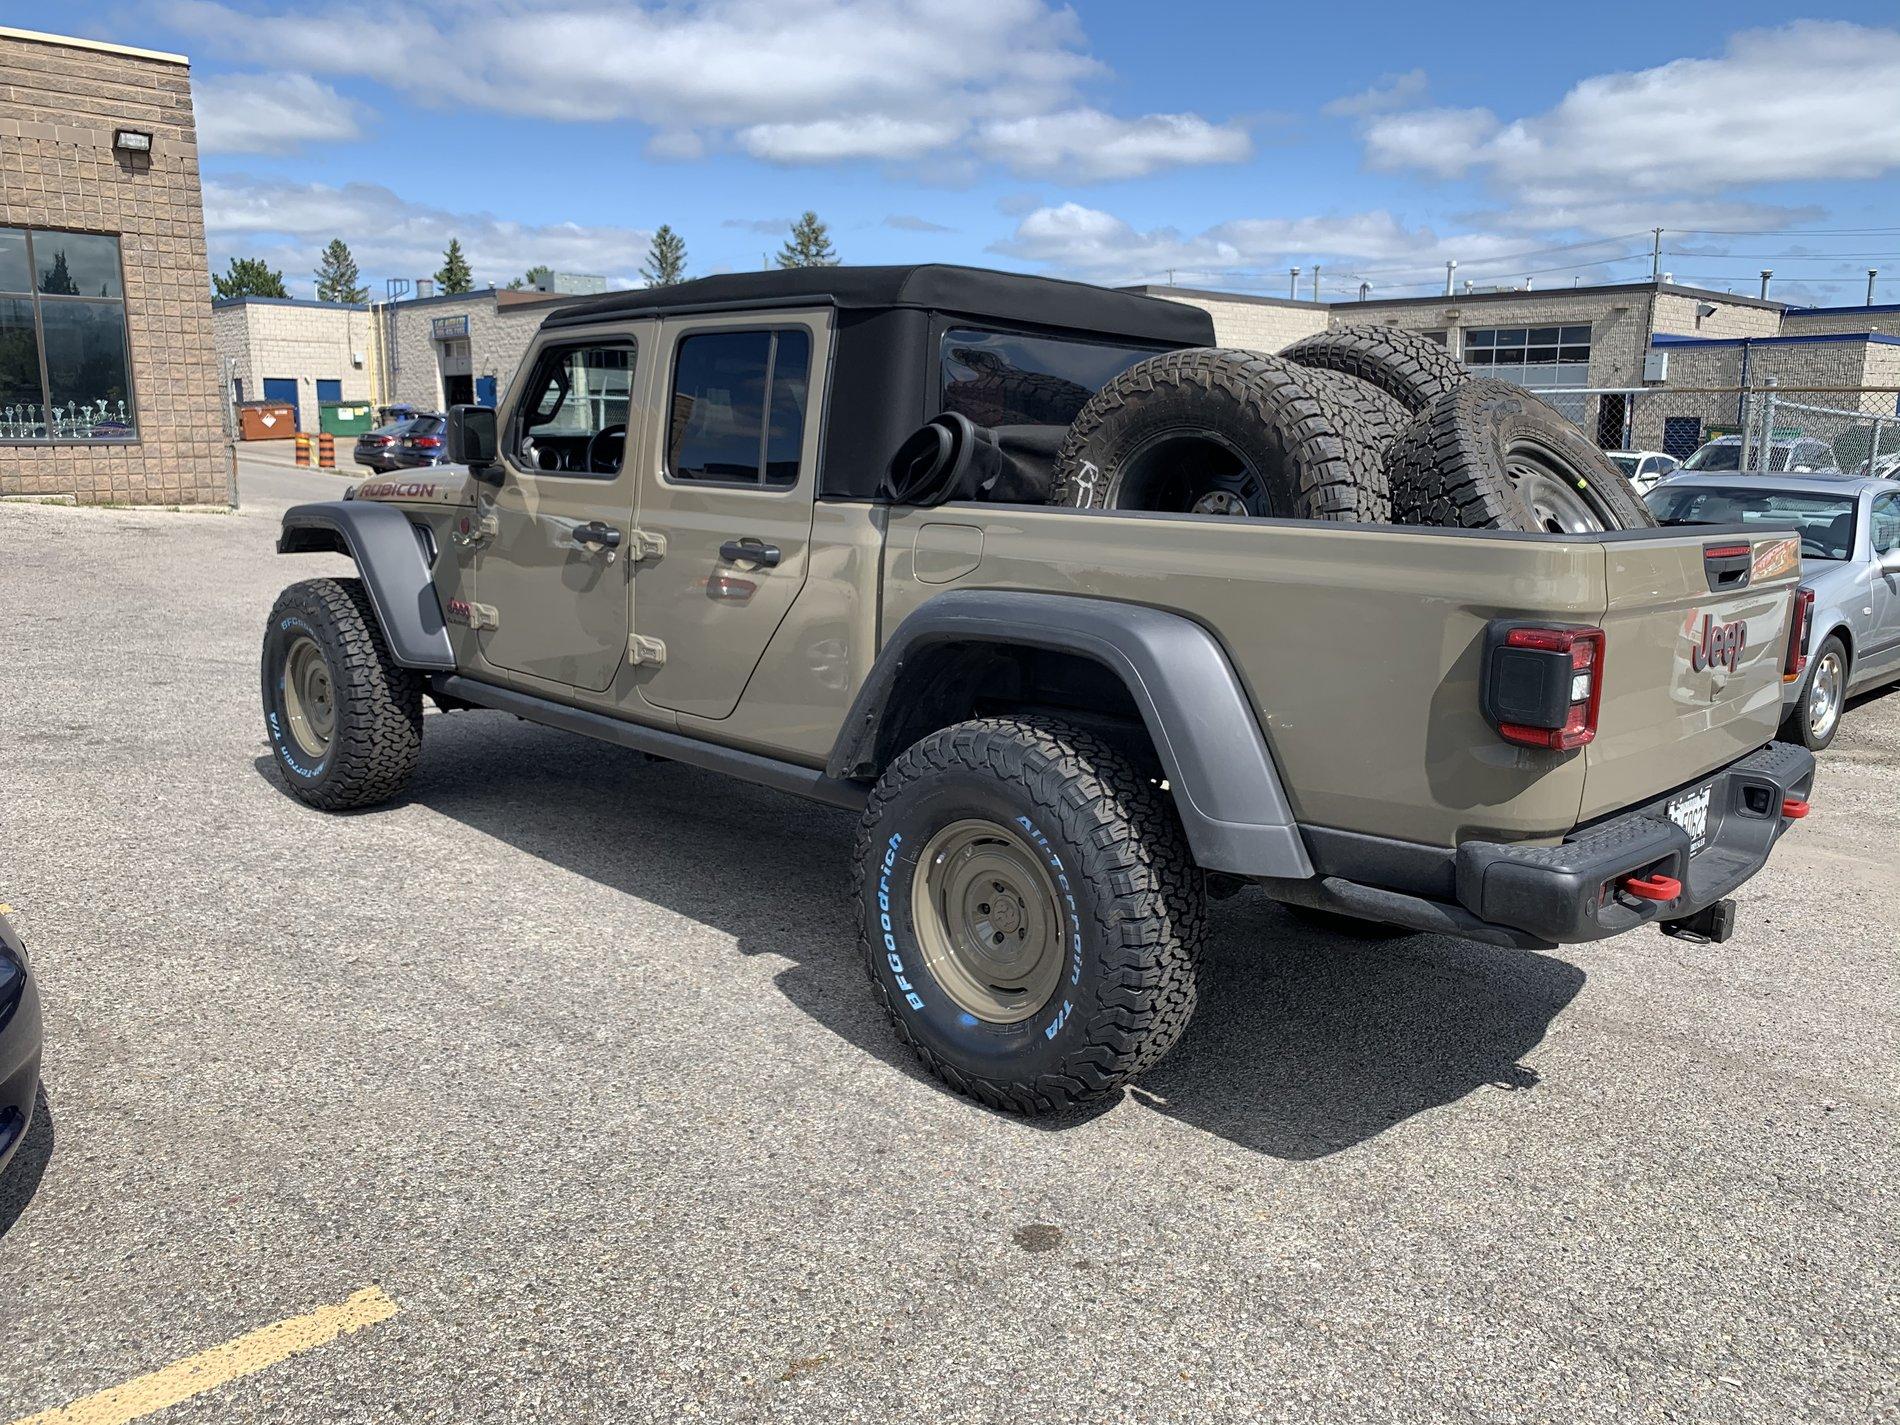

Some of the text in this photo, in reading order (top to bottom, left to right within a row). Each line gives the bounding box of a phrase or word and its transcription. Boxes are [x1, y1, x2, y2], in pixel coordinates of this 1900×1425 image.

[359, 483, 436, 498] RUBICON
[1691, 613, 1747, 673] Jeep
[270, 711, 281, 740] T/A
[877, 832, 925, 1010] BFGoodrich
[1015, 815, 1082, 1040] All-Terrain T/A
